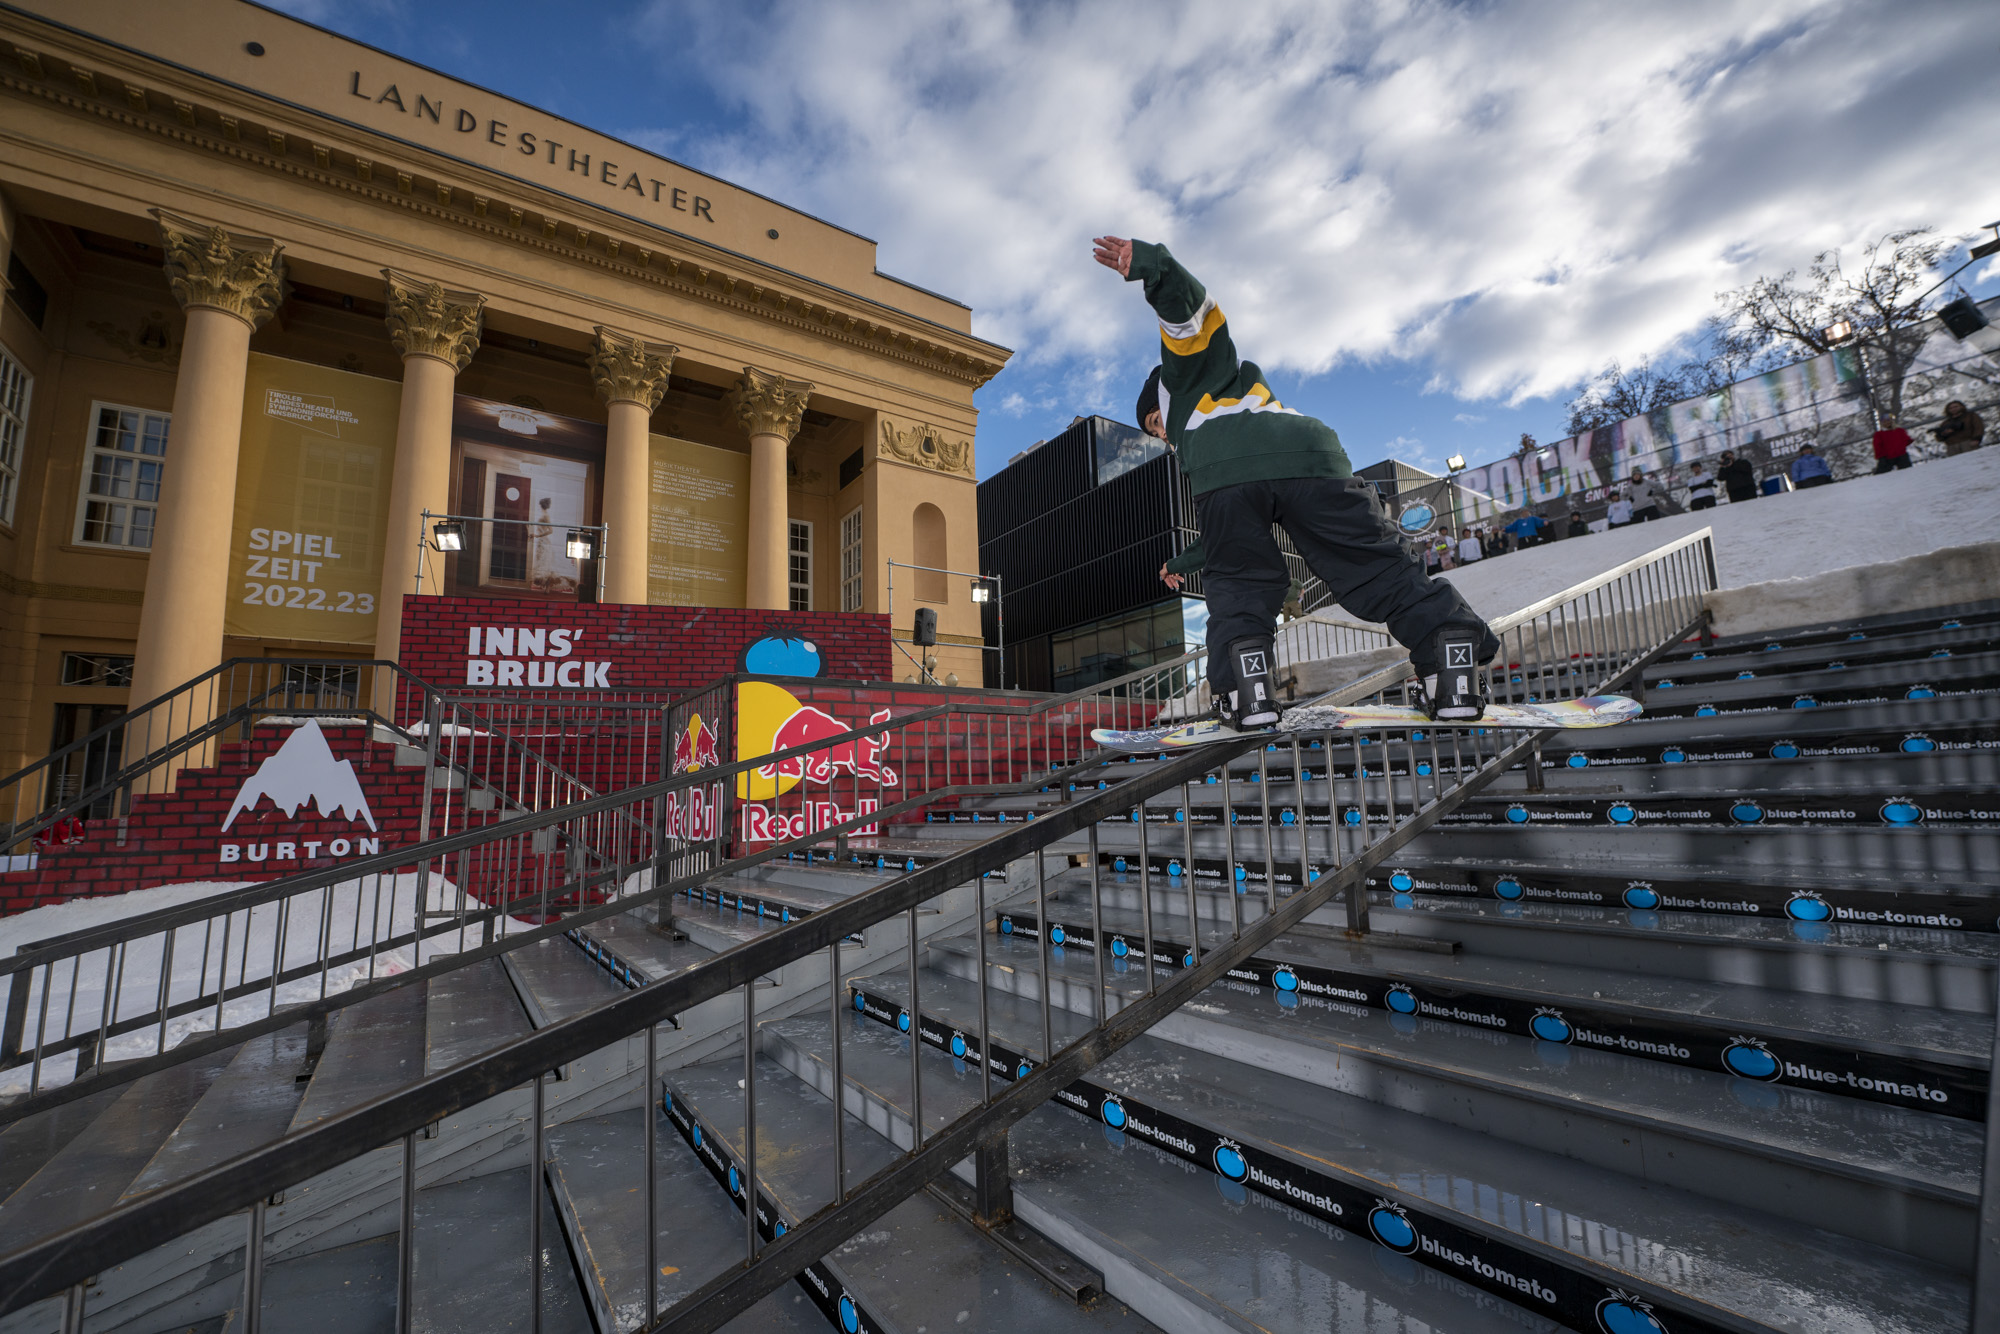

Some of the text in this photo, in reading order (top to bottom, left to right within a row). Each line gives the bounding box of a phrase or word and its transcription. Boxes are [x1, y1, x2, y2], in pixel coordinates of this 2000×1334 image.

[350, 70, 715, 223] LANDESTHEATER
[268, 391, 302, 402] TIROLER
[269, 397, 352, 417] LANDESTHEATER UND
[267, 408, 313, 422] INNSBRUCK
[268, 403, 359, 424] SYMPHONIEORCHESTER
[1458, 430, 1601, 523] ROCK
[248, 528, 341, 559] SPIEL
[245, 554, 323, 583] ZEIT
[242, 582, 375, 614] 2022.23
[468, 627, 584, 657] INNS'
[466, 659, 612, 688] BRUCK
[1590, 756, 1647, 766] blue-tomato
[1688, 751, 1754, 761] blue-tomato
[1802, 744, 1880, 756] blue-tomato
[1530, 810, 1593, 820] blue-tomato
[1638, 809, 1711, 819] blue-tomato
[1767, 809, 1856, 820] blue-tomato
[219, 837, 379, 863] BURTON
[1415, 880, 1478, 893] blue-tomato
[1525, 887, 1603, 902] blue-tomato
[1662, 896, 1760, 913] blue-tomato
[1836, 906, 1963, 928] blue-tomato
[1300, 980, 1368, 1002] blue-tomato
[1420, 1001, 1507, 1028] blue-tomato
[1575, 1028, 1691, 1060] blue-tomato
[1785, 1061, 1948, 1104] blue-tomato
[1128, 1116, 1196, 1154] blue-tomato
[1250, 1166, 1343, 1216] blue-tomato
[1421, 1235, 1557, 1304] blue-tomato
